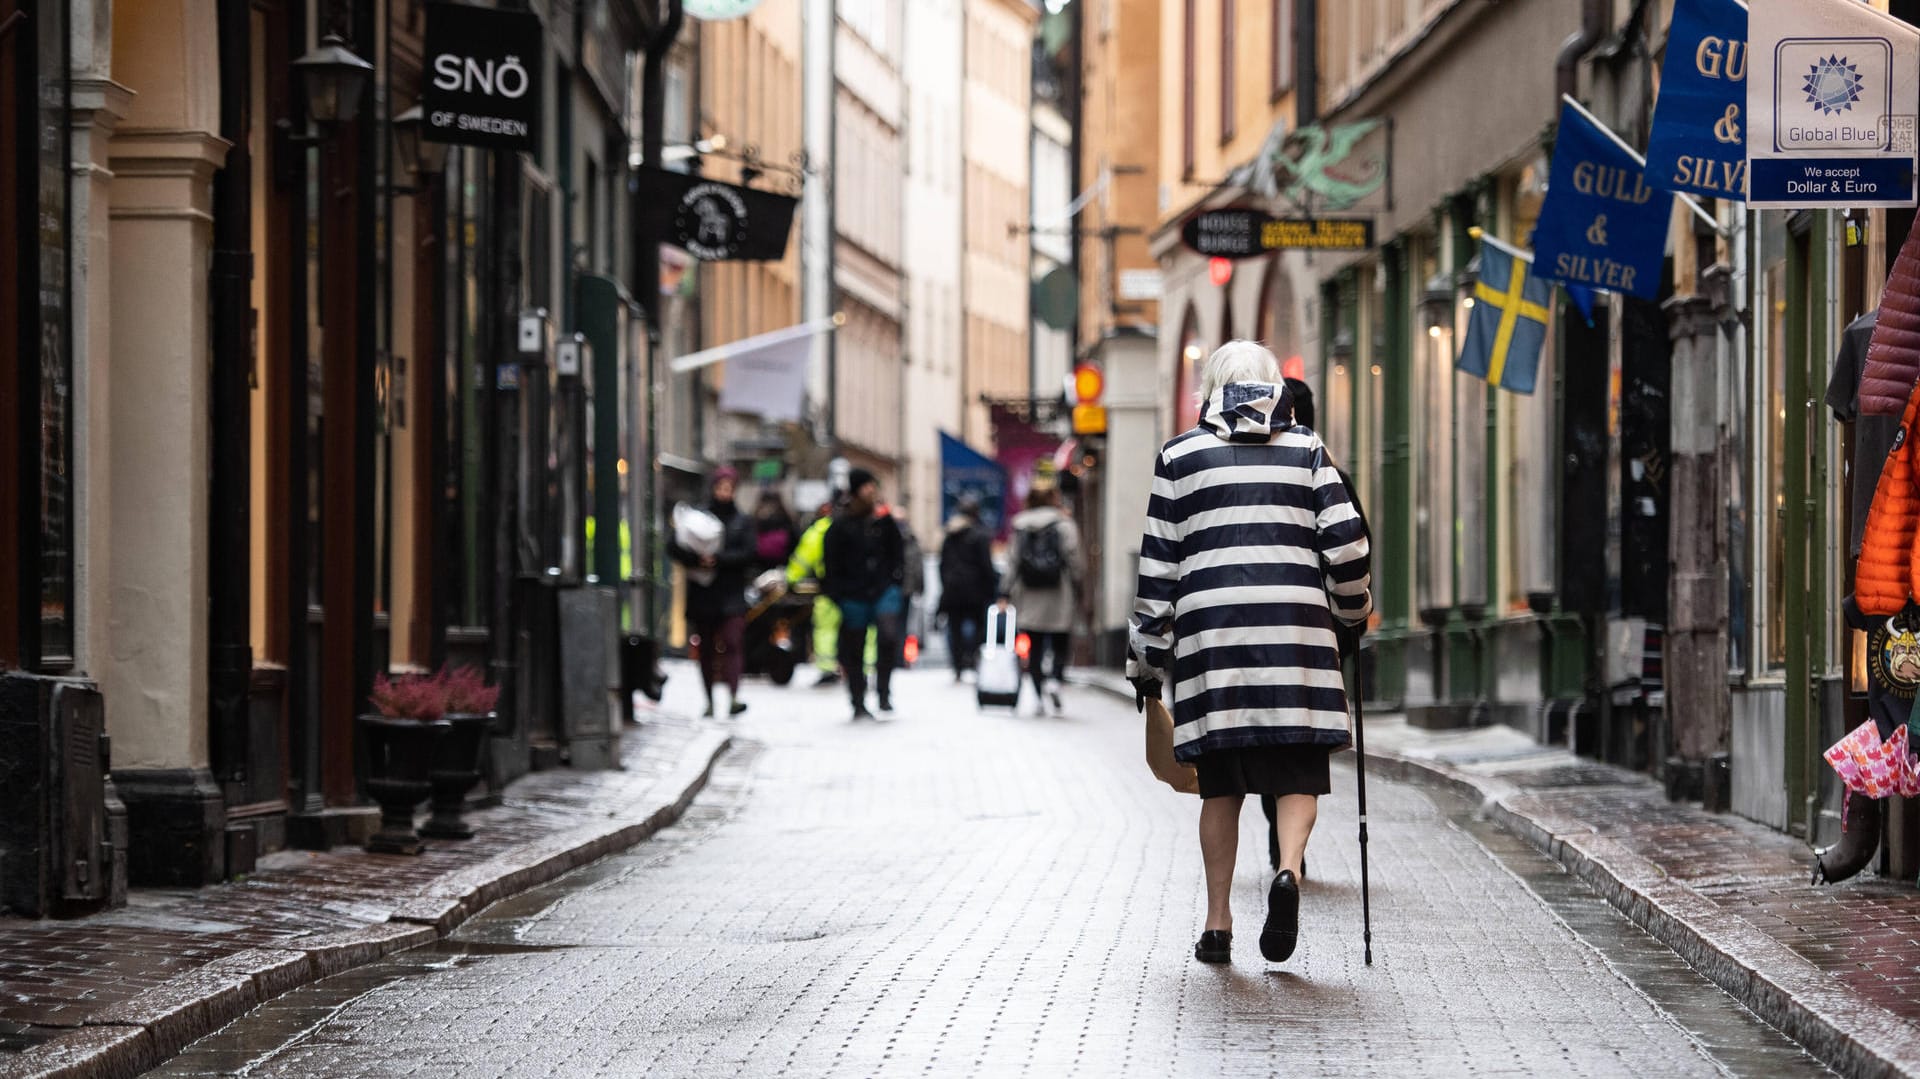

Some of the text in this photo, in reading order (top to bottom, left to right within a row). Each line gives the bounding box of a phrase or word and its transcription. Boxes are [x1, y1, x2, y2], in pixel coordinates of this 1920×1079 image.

[433, 54, 529, 98] SNÖ
[431, 111, 528, 136] OF SWEDEN
[1714, 103, 1742, 144] &
[1789, 127, 1876, 142] Global Blue
[1573, 161, 1652, 204] GULD
[1787, 181, 1877, 193] Dollar & Euro
[1804, 167, 1860, 179] We accept
[1586, 214, 1608, 245] &
[1555, 253, 1637, 291] SILVER
